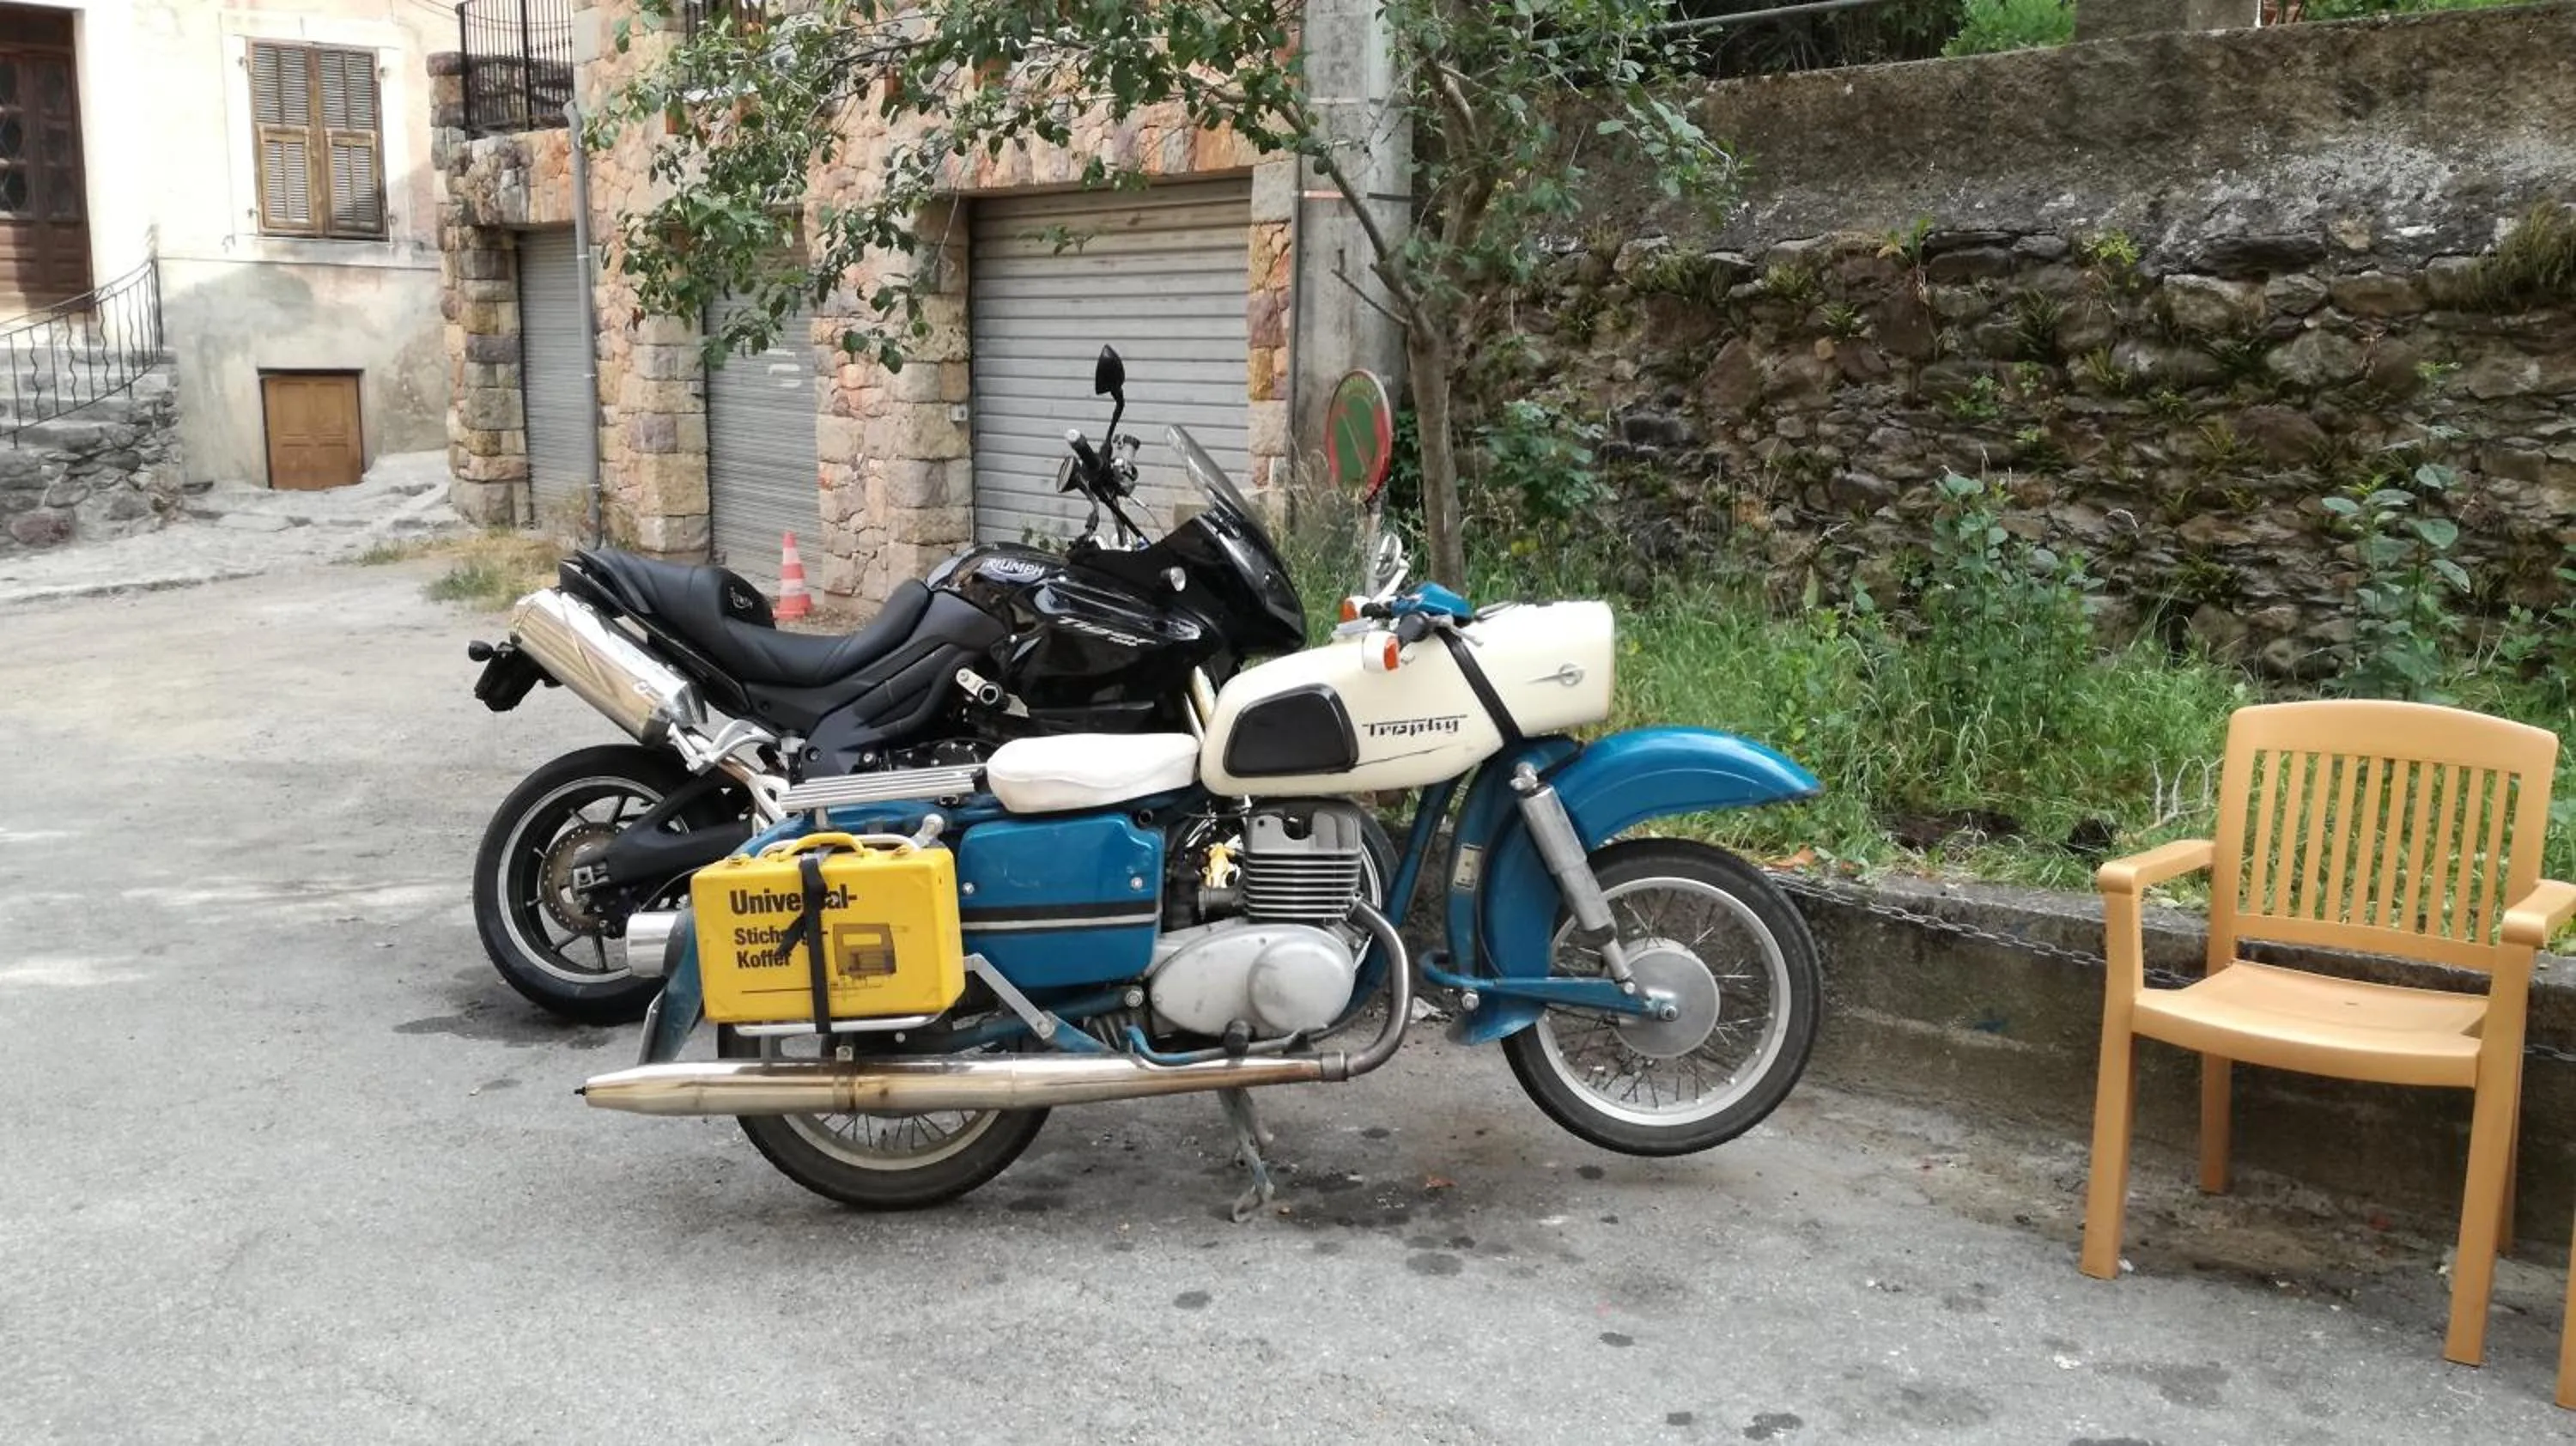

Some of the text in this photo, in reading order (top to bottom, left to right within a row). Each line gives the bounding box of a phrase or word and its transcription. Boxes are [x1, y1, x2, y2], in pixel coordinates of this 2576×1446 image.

[1362, 714, 1467, 737] Trophy
[730, 883, 857, 914] Univeal-
[736, 949, 792, 969] Koffer
